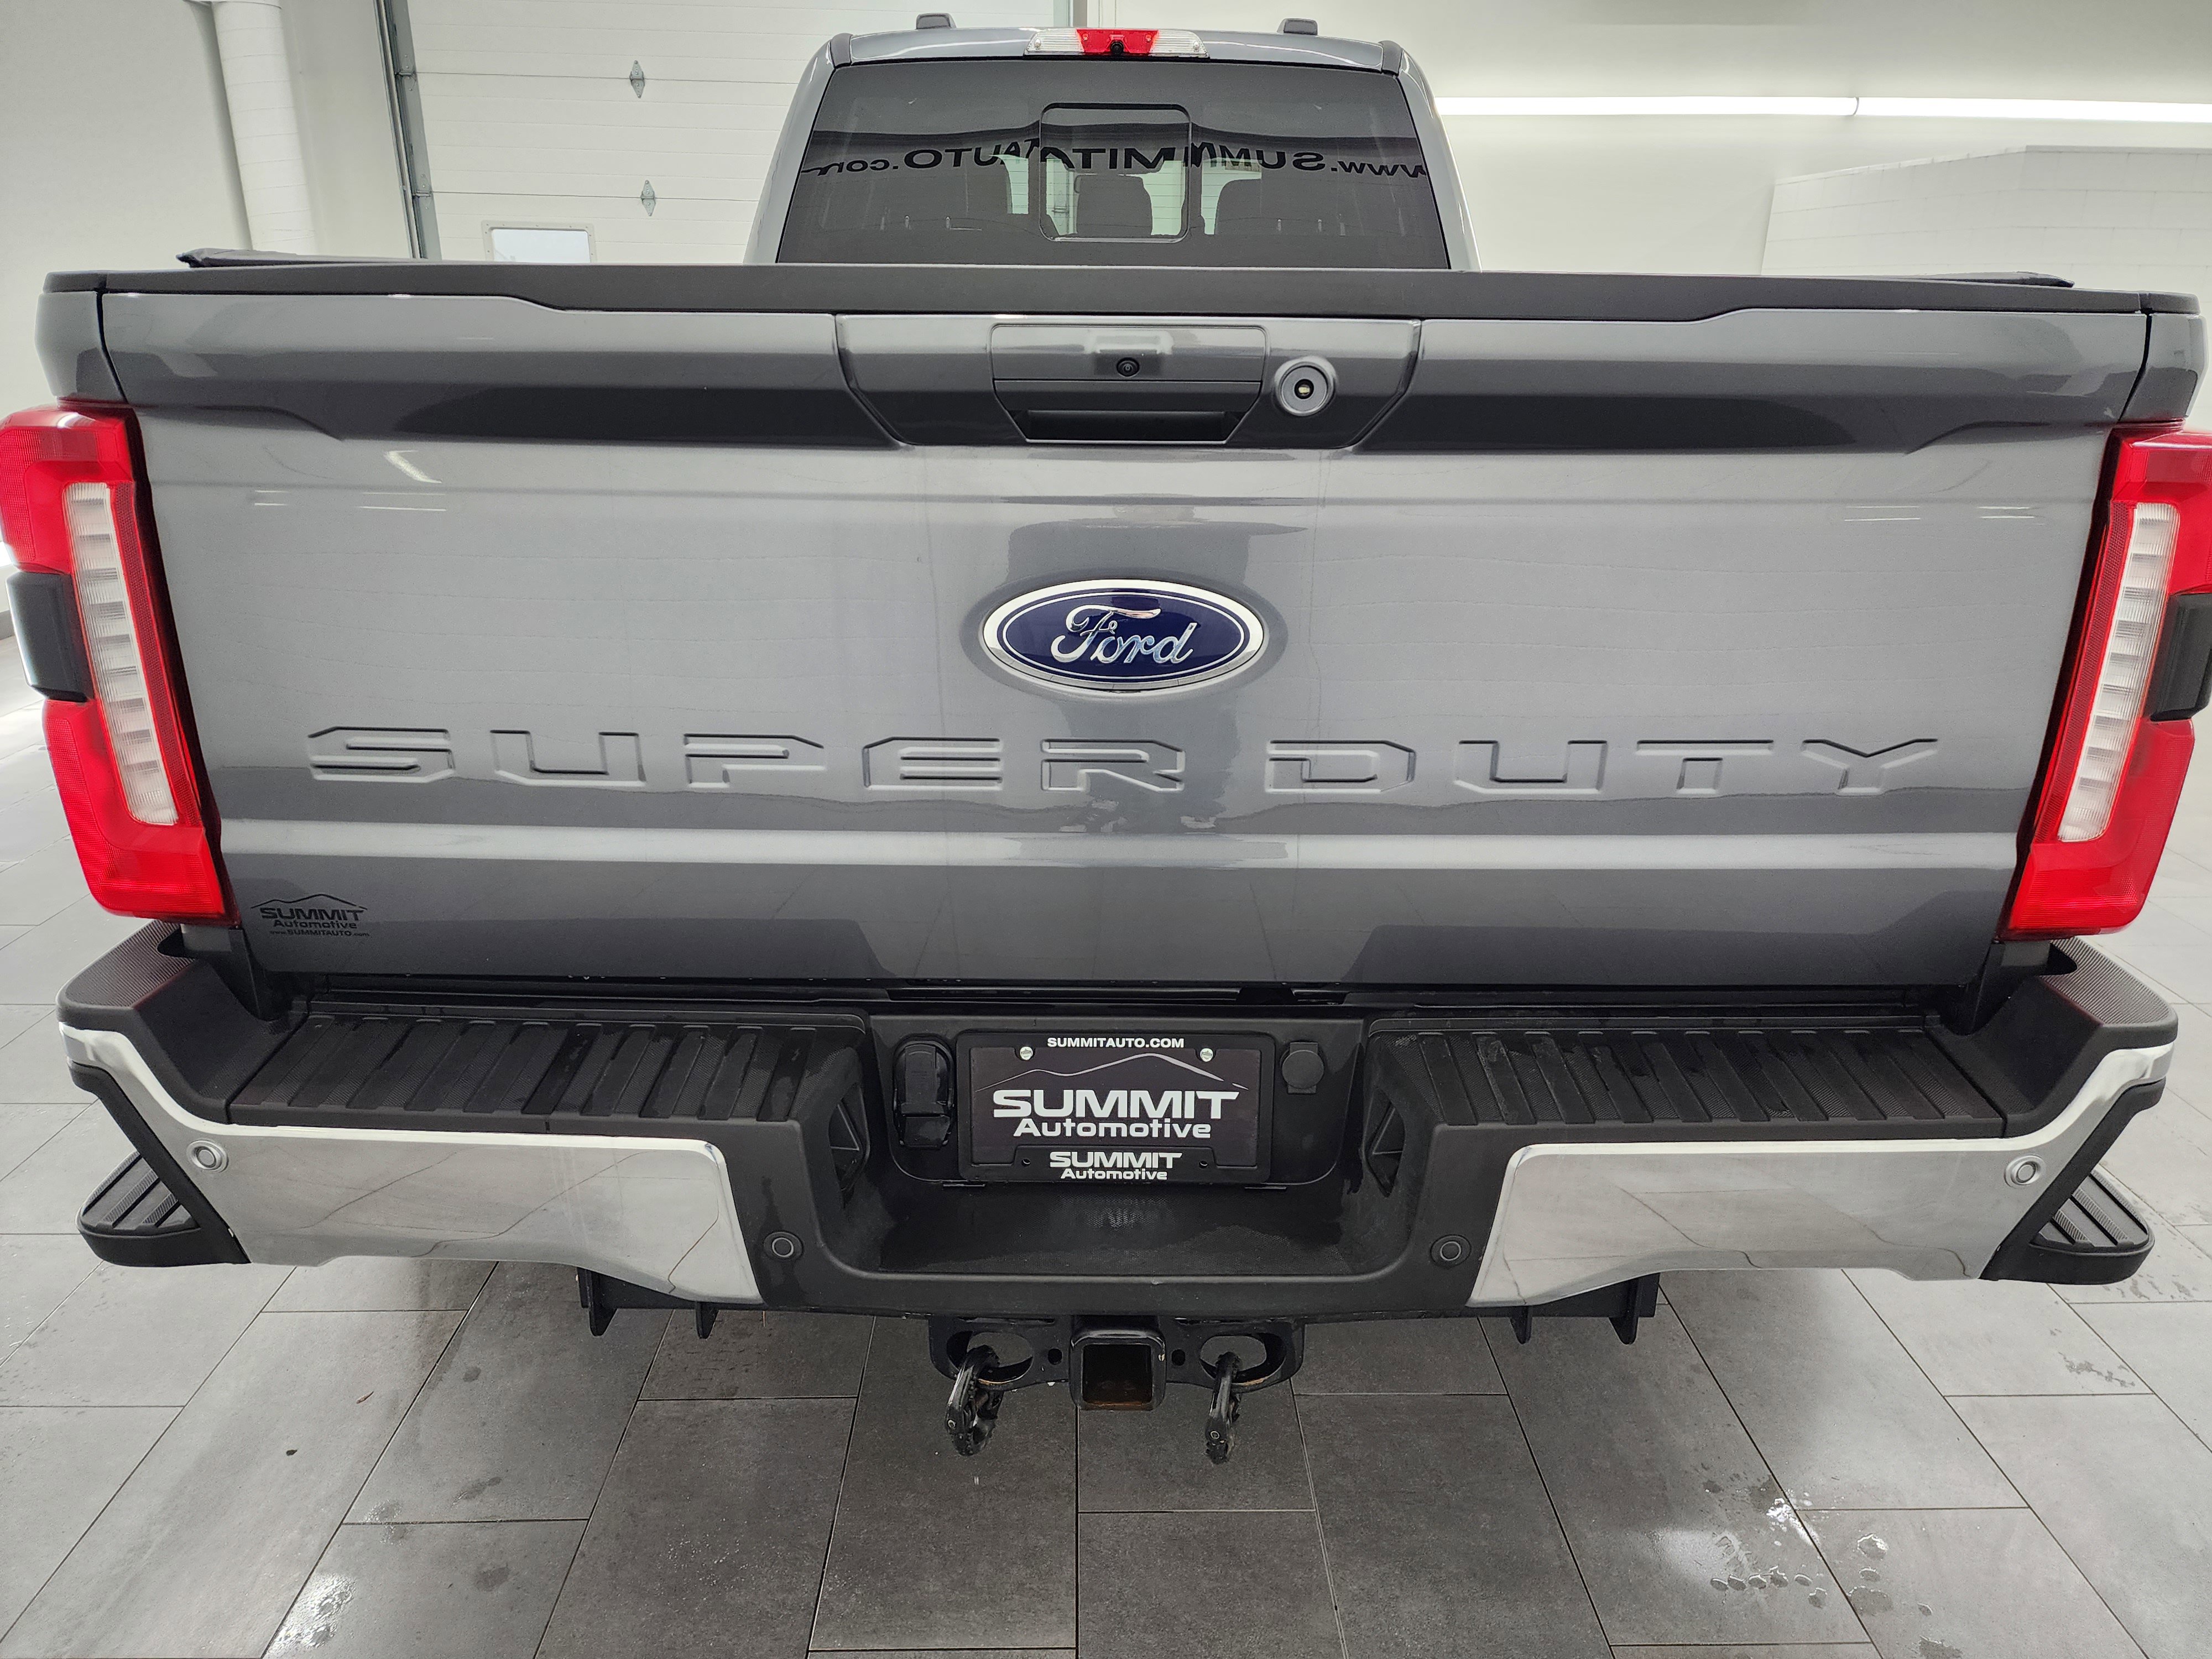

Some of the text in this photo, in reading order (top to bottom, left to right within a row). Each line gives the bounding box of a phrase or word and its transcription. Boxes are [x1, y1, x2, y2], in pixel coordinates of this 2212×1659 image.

[1051, 604, 1197, 664] Ford
[308, 726, 1938, 795] SUPER DUTY
[260, 907, 364, 921] SUMMIT
[273, 920, 357, 929] Automotive
[1047, 1037, 1185, 1048] SUMMITAUTO.COM
[993, 1089, 1239, 1119] SUMMIT
[1013, 1118, 1211, 1138] Automotive
[1049, 1151, 1182, 1168] SUMMIT
[1060, 1168, 1167, 1180] Automotive
